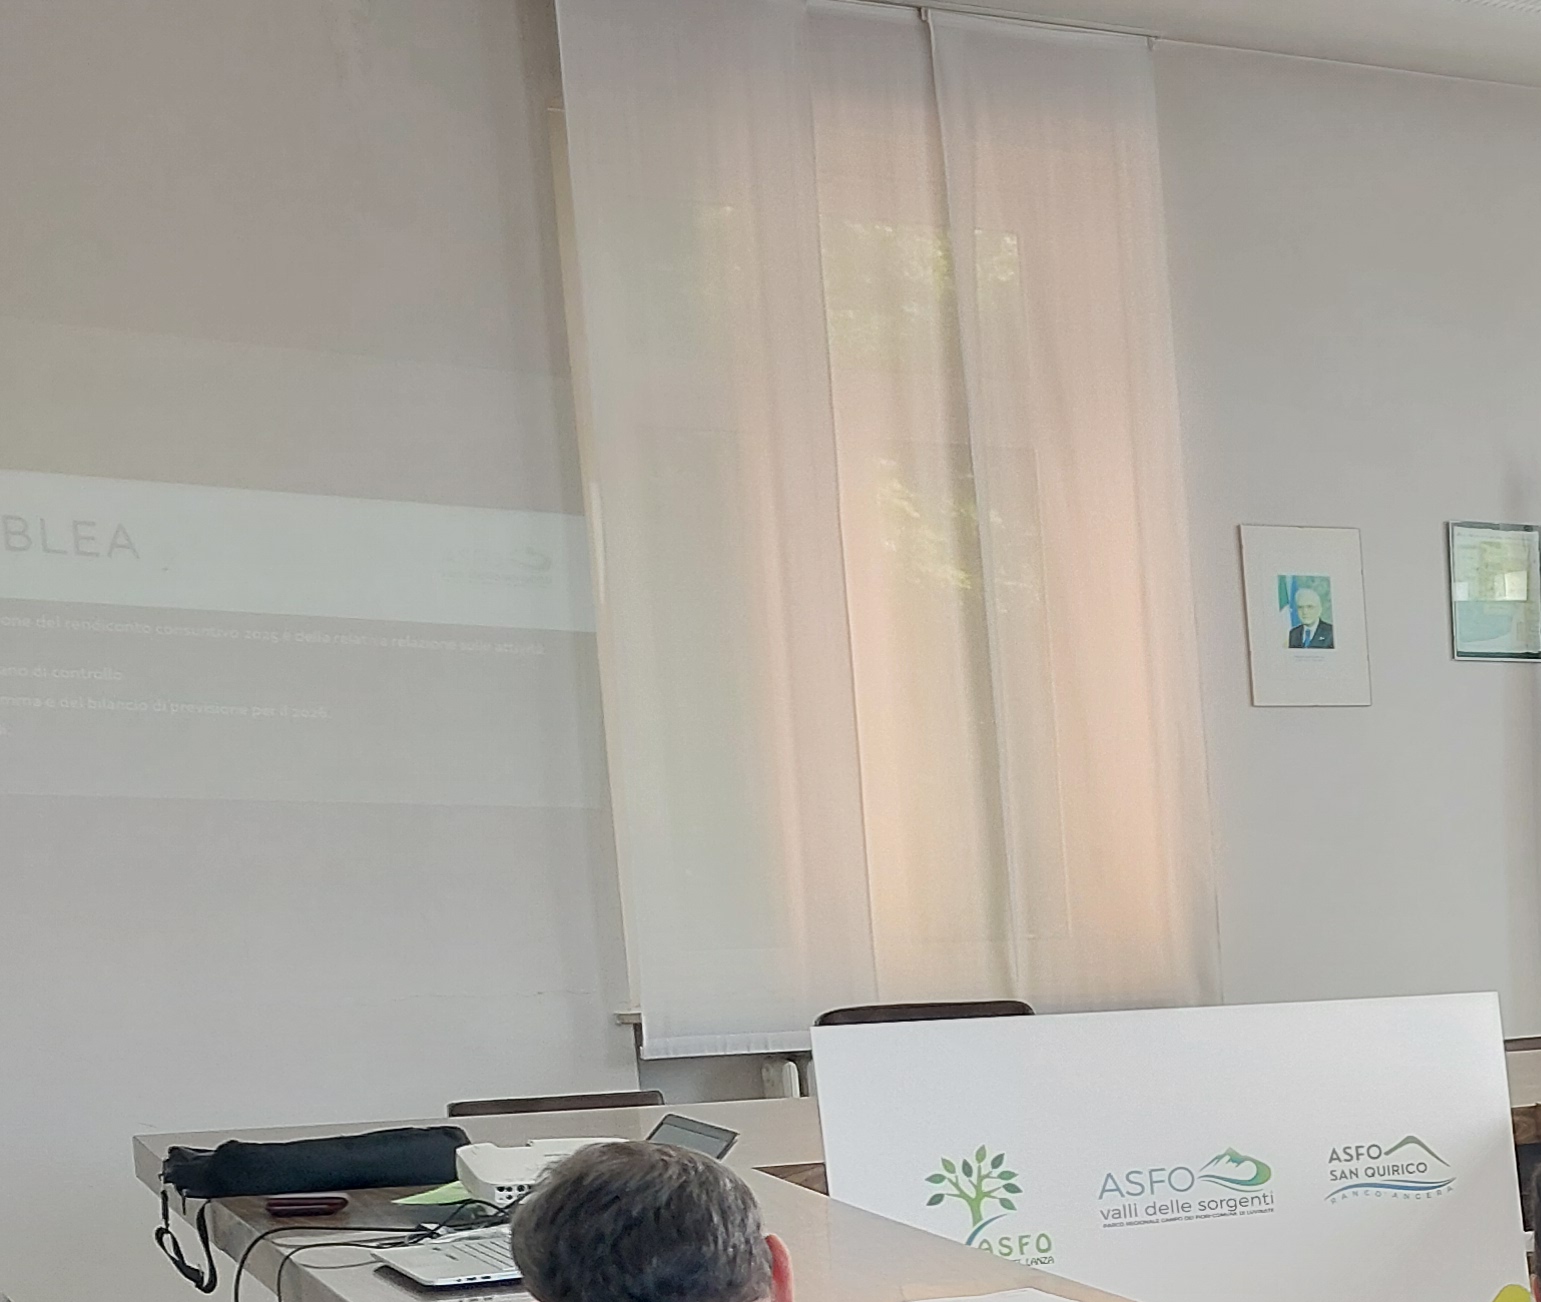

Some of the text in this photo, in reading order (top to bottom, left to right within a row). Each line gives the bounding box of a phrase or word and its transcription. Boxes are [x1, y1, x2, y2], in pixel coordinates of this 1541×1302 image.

[1328, 1143, 1383, 1164] ASFO
[1098, 1166, 1195, 1200] ASFO
[1330, 1162, 1428, 1182] SAN QUIRICO
[1099, 1190, 1275, 1221] valli delle sorgenti
[977, 1232, 1053, 1257] ASFO
